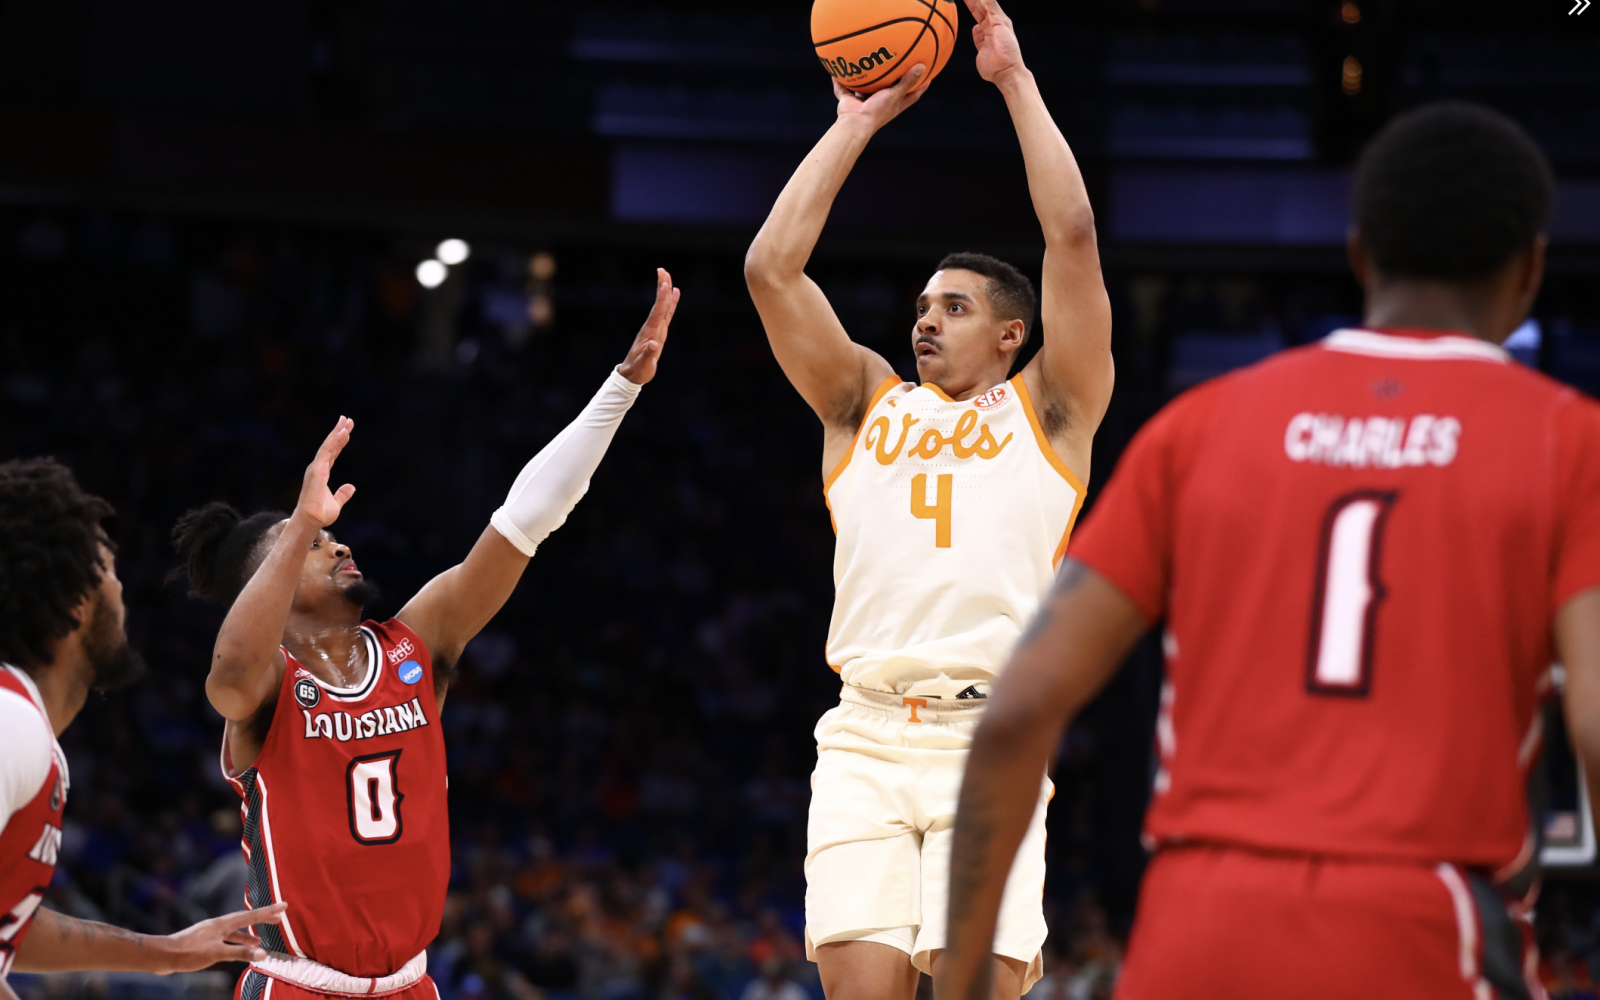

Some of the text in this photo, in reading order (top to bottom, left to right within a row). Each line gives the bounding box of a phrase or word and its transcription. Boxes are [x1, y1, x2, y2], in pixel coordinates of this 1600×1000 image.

[977, 389, 1004, 406] SEC
[865, 409, 1013, 465] Vols
[1284, 412, 1462, 468] CHARLES
[911, 473, 953, 548] 4
[1305, 489, 1397, 697] 1
[300, 684, 315, 700] GS
[403, 666, 422, 681] NCAA
[303, 697, 429, 741] LOUISIANA
[903, 697, 927, 723] T
[346, 748, 405, 846] 0
